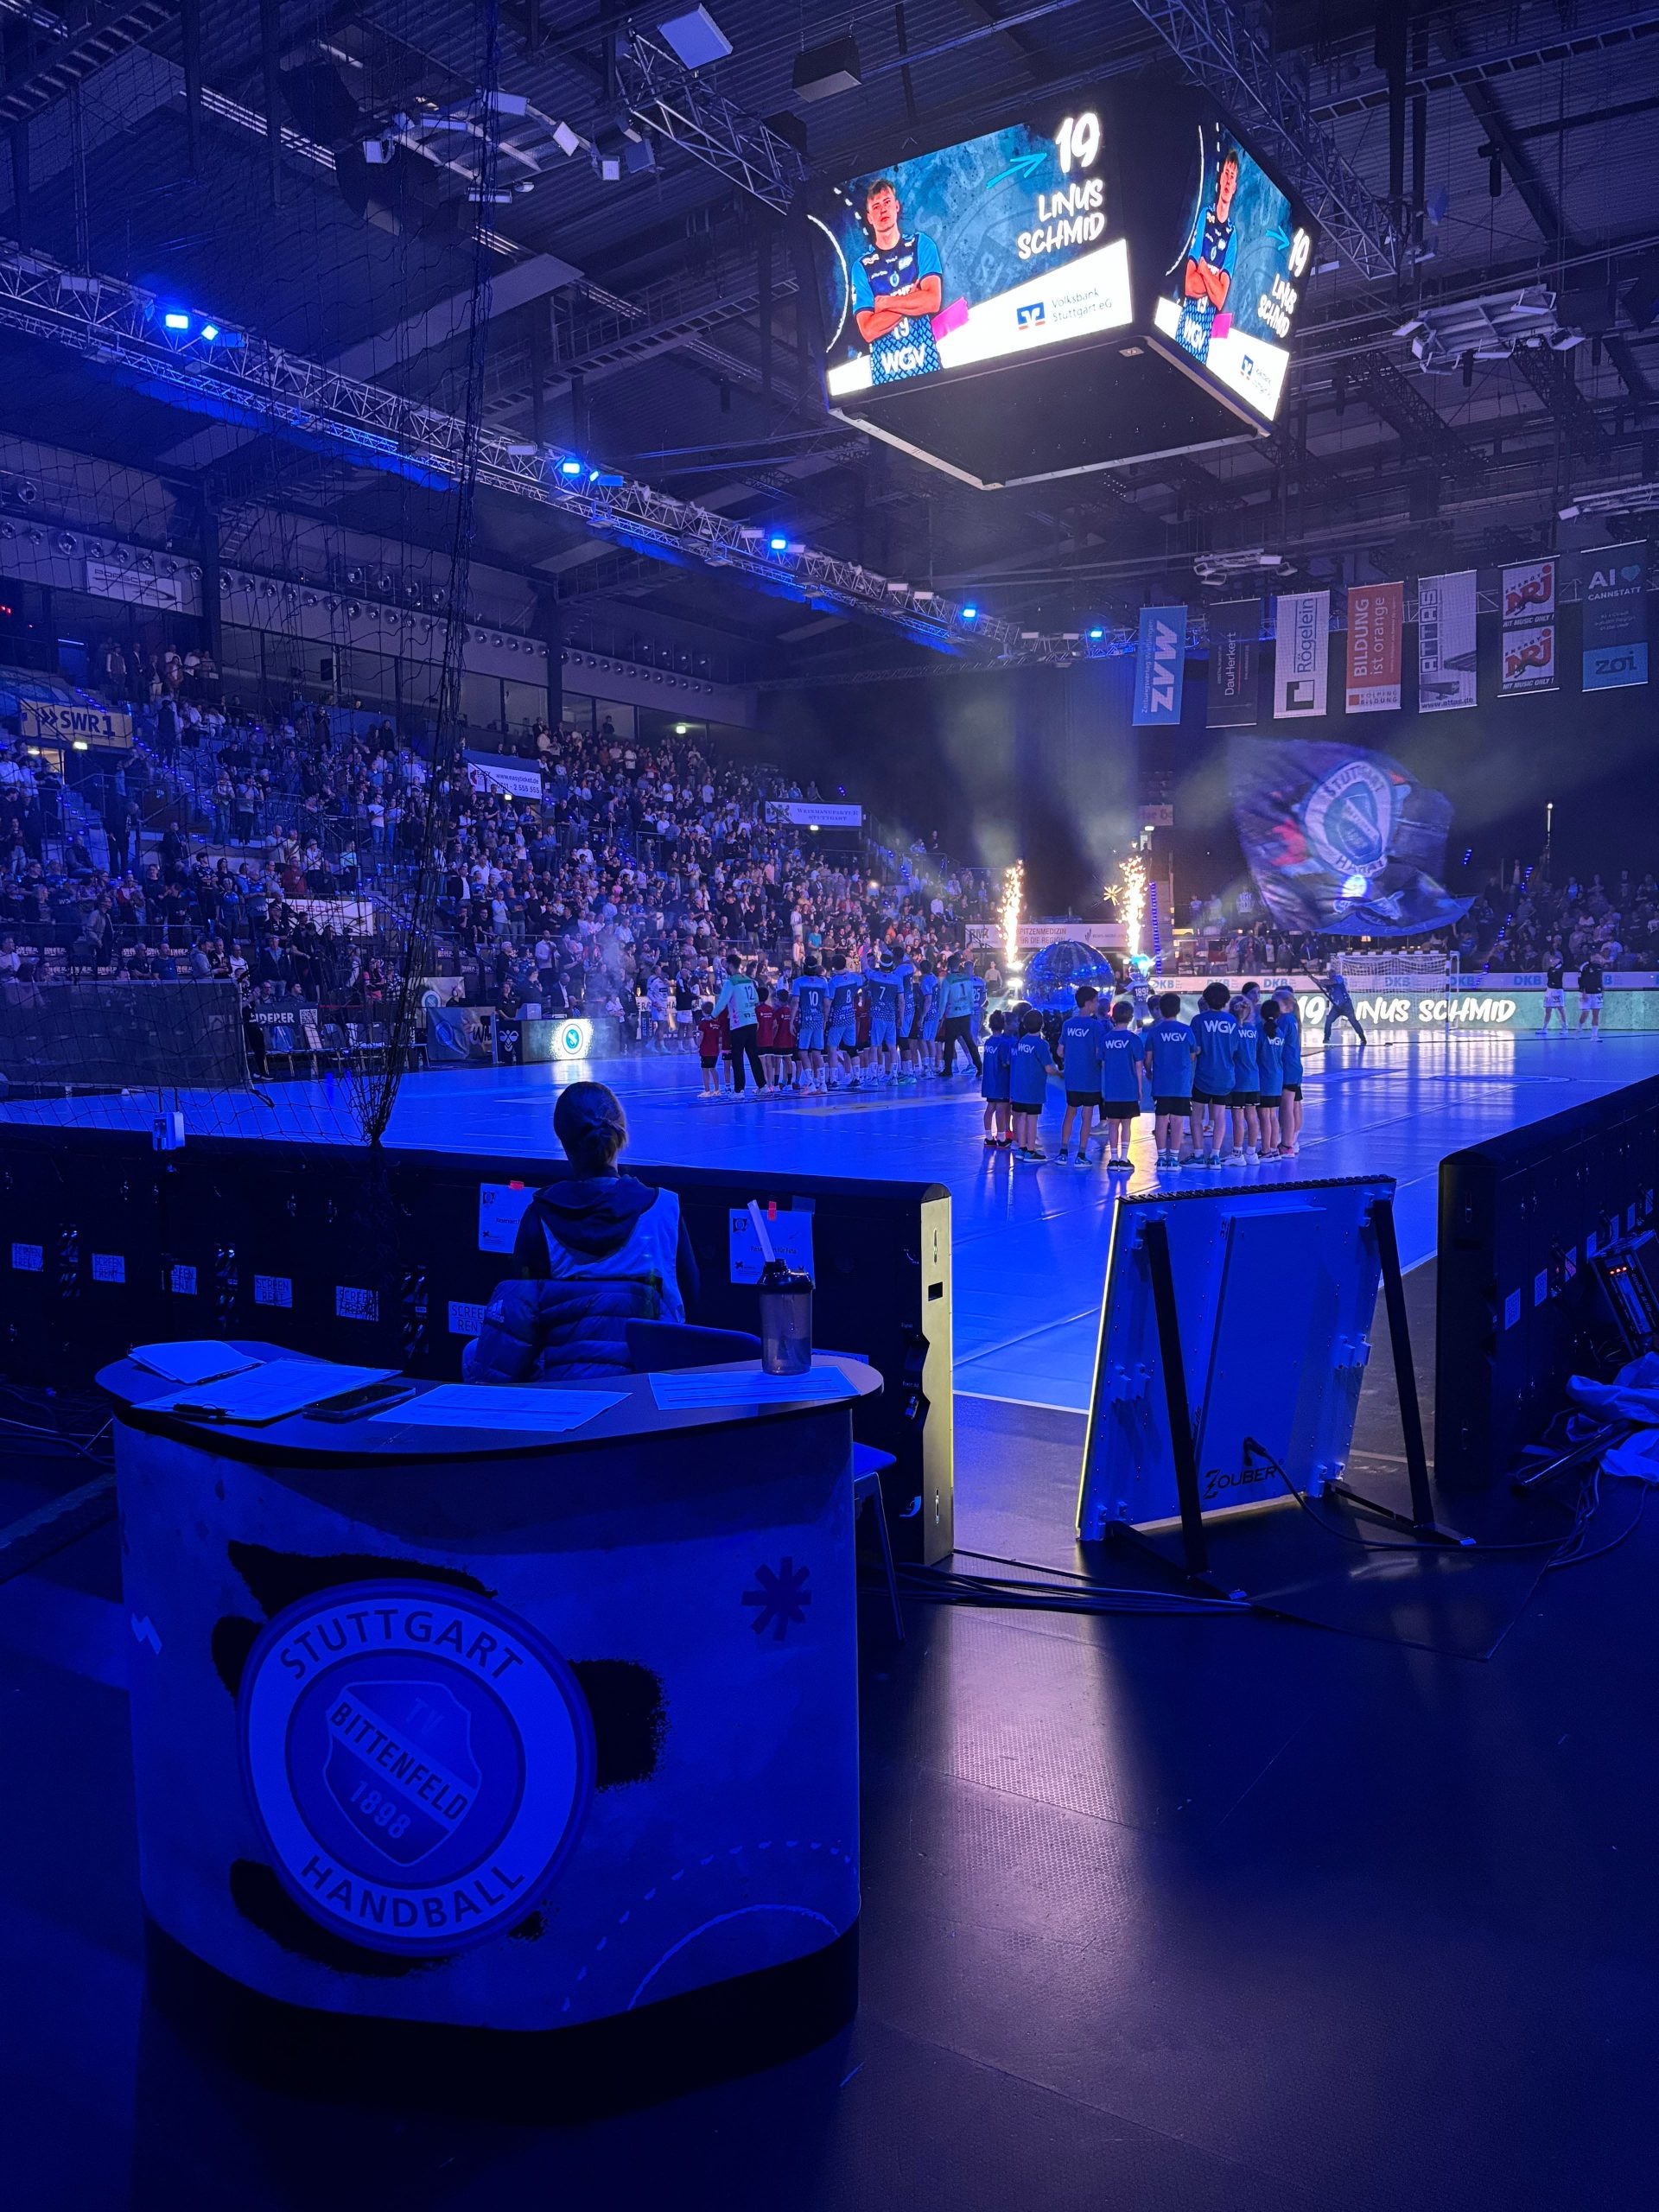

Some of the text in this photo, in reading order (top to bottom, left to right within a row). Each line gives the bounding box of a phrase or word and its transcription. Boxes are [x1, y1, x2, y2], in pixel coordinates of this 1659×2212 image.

[1055, 112, 1101, 174] 19
[1038, 178, 1103, 222] LINUS
[1017, 212, 1105, 260] SCHMID
[1288, 227, 1310, 276] 19
[1051, 288, 1100, 308] Volksbank
[1272, 273, 1297, 314] LINUS
[1052, 299, 1113, 323] Stuttgart eG
[1258, 294, 1290, 338] SCHMID
[1184, 318, 1205, 351] WGV
[880, 343, 925, 375] WGV
[1505, 564, 1552, 616] NRJ
[1588, 569, 1616, 589] AI
[1588, 586, 1642, 601] CANNSTATT
[1297, 598, 1316, 673] Rögelein
[1353, 599, 1370, 677] BILDUNG
[1370, 597, 1389, 675] ist orange
[1420, 588, 1438, 673] ATTAS
[1503, 619, 1513, 627] HIT
[1514, 617, 1533, 626] MUSIC
[1151, 620, 1178, 713] ZVW
[1224, 632, 1236, 696] DauHerkert
[1505, 628, 1552, 678] NRJ
[1141, 662, 1152, 713] Zeitungsverlag
[1514, 680, 1533, 689] MUSIC
[1421, 696, 1474, 709] www.attas.de
[1020, 927, 1066, 936] PITZENMEDIZIN
[744, 985, 754, 1001] 12
[846, 988, 851, 1004] 8
[880, 986, 887, 1001] 7
[1514, 976, 1541, 985] DKB
[808, 990, 818, 1007] 10
[1296, 995, 1516, 1025] 19 INUS SCHMID
[1067, 1027, 1090, 1037] WGV
[1160, 1033, 1187, 1042] WGV
[1204, 1020, 1236, 1034] WGV
[1238, 1029, 1257, 1039] WGV
[1018, 1043, 1035, 1053] WGV
[1105, 1039, 1129, 1049] WGV
[451, 1304, 485, 1320] SCREE
[279, 1608, 524, 1680] STUTTGART
[405, 1696, 445, 1736] TV
[330, 1700, 468, 1821] BITTENFELD
[349, 1779, 411, 1840] 1898
[300, 1855, 525, 1929] HANDBALL
